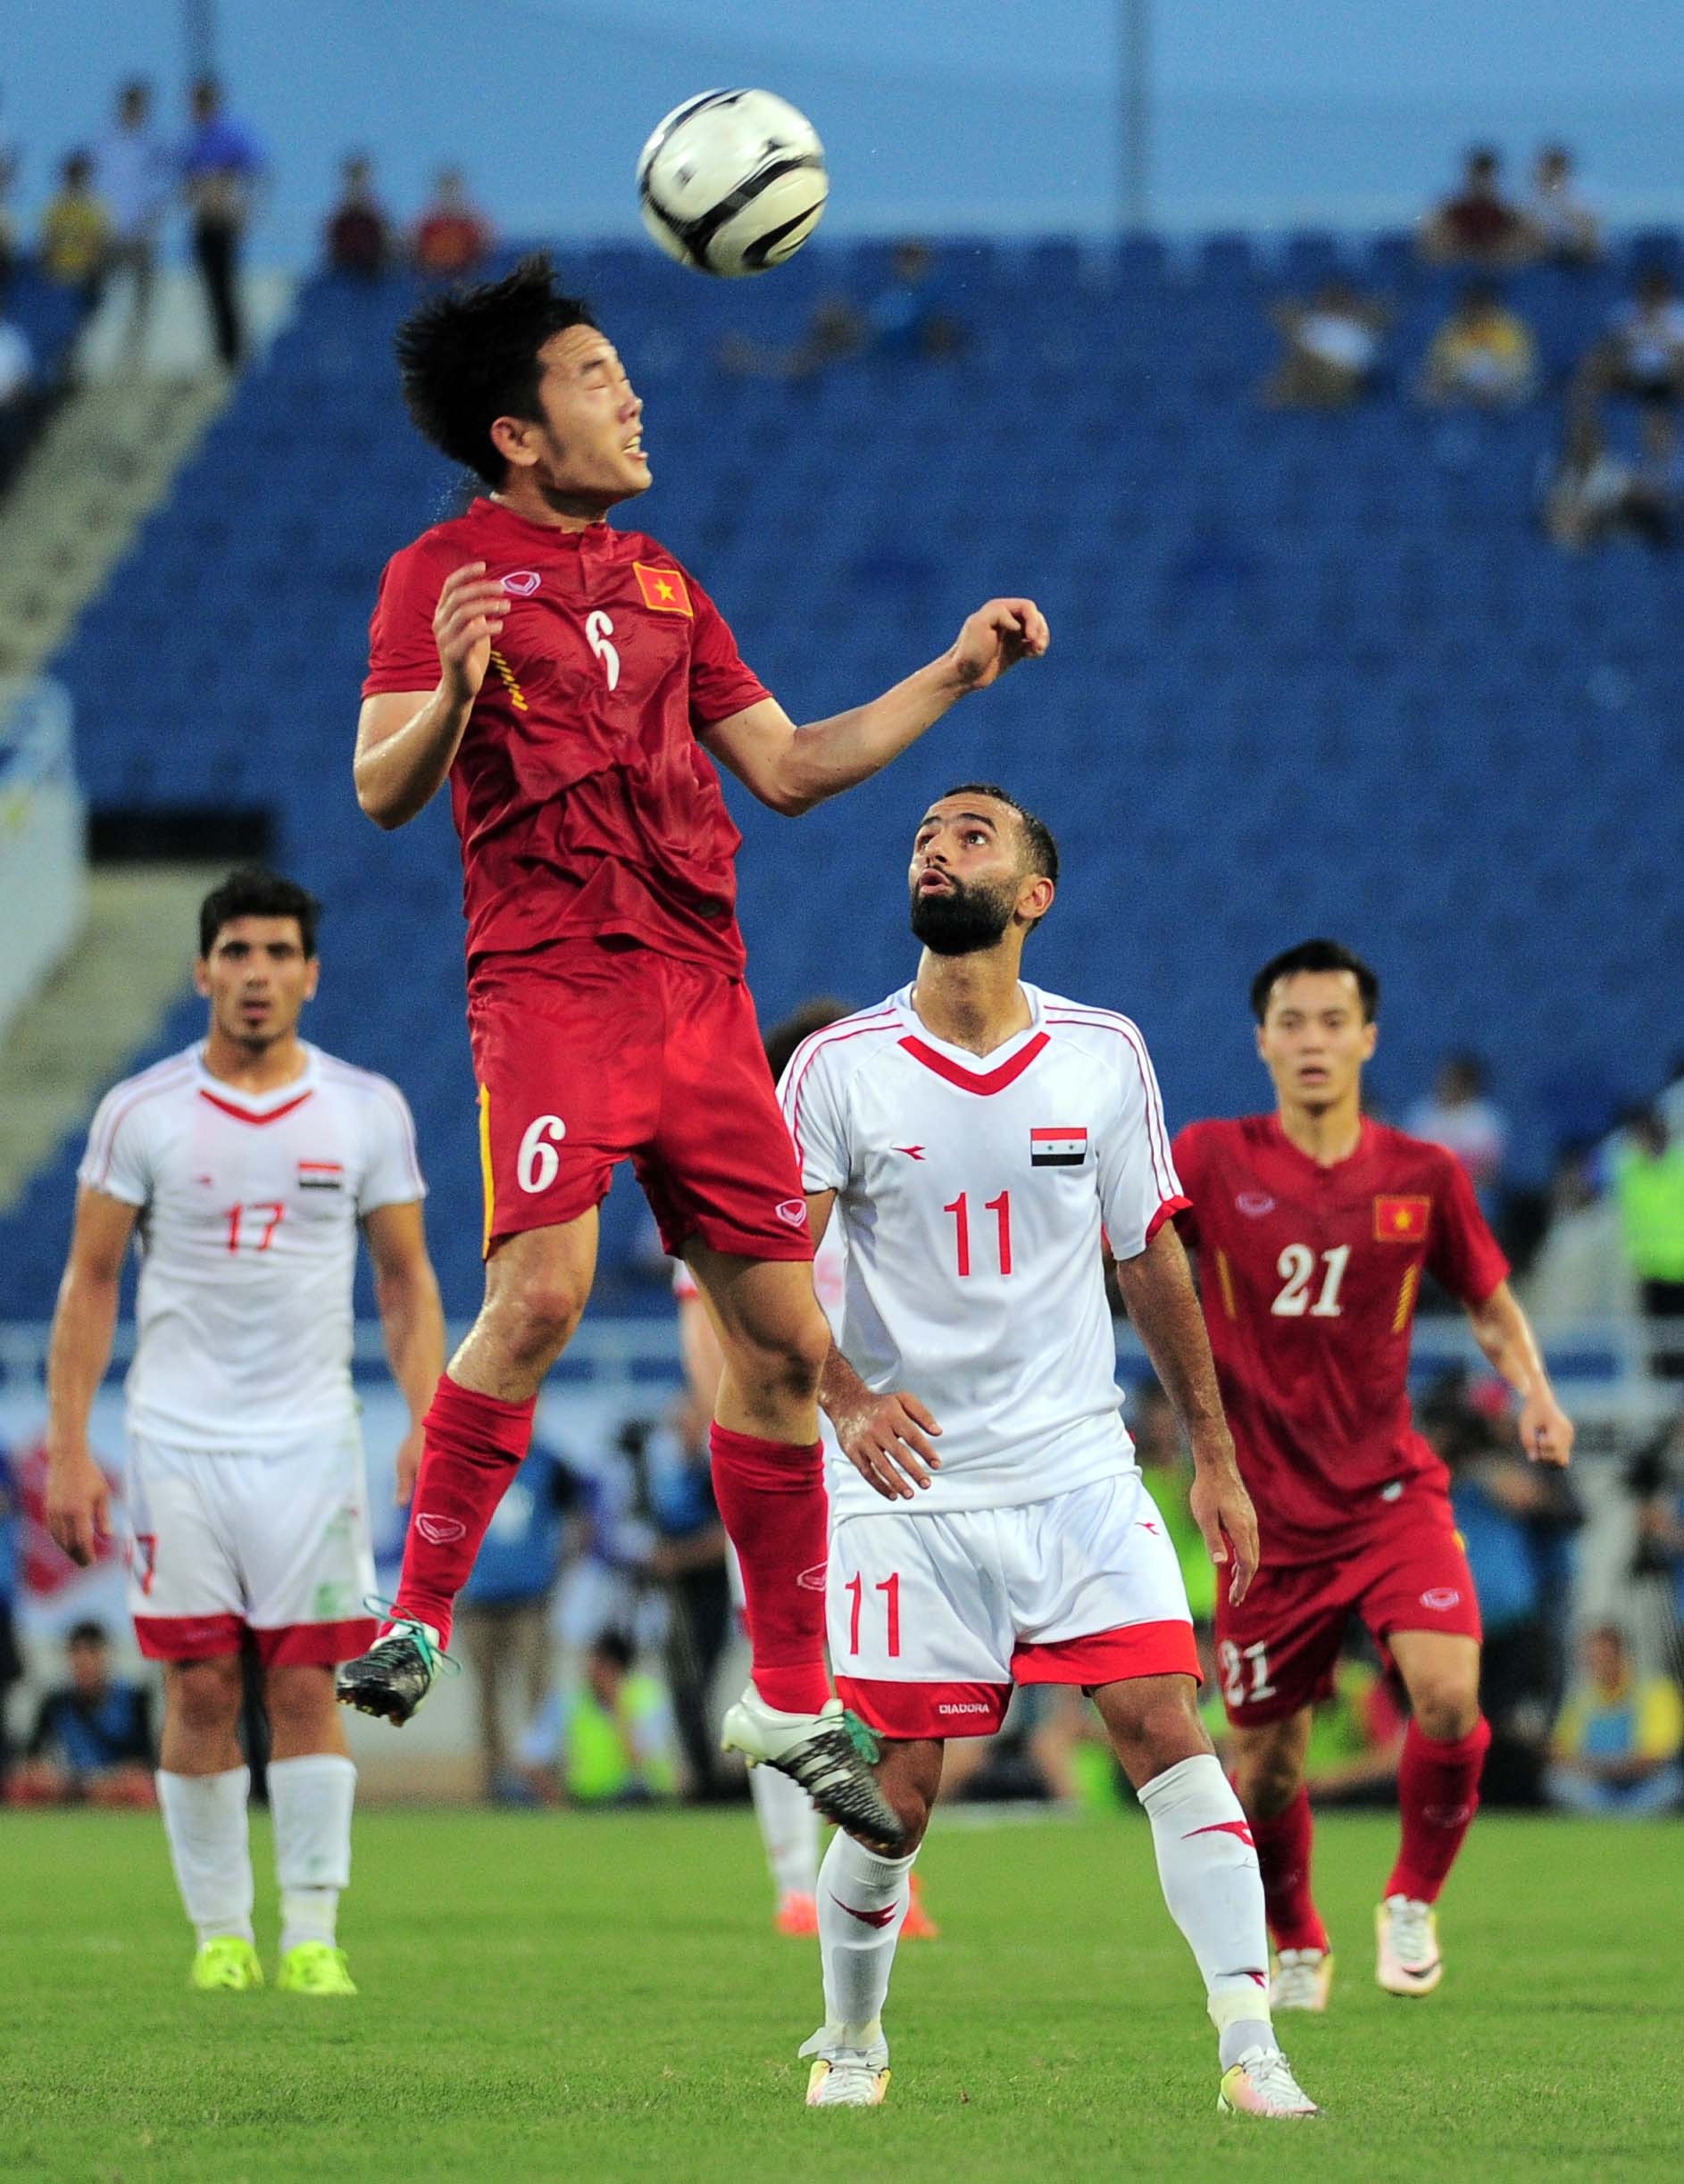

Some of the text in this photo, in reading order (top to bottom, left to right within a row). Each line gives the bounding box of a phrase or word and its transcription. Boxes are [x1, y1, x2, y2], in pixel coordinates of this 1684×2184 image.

[517, 1114, 566, 1193] 6
[222, 1201, 284, 1254] 17
[944, 1191, 1012, 1275] 11
[1271, 1243, 1352, 1316] 21
[845, 1570, 899, 1657] 11
[938, 1704, 989, 1713] DIADORA
[1221, 1639, 1276, 1706] 21
